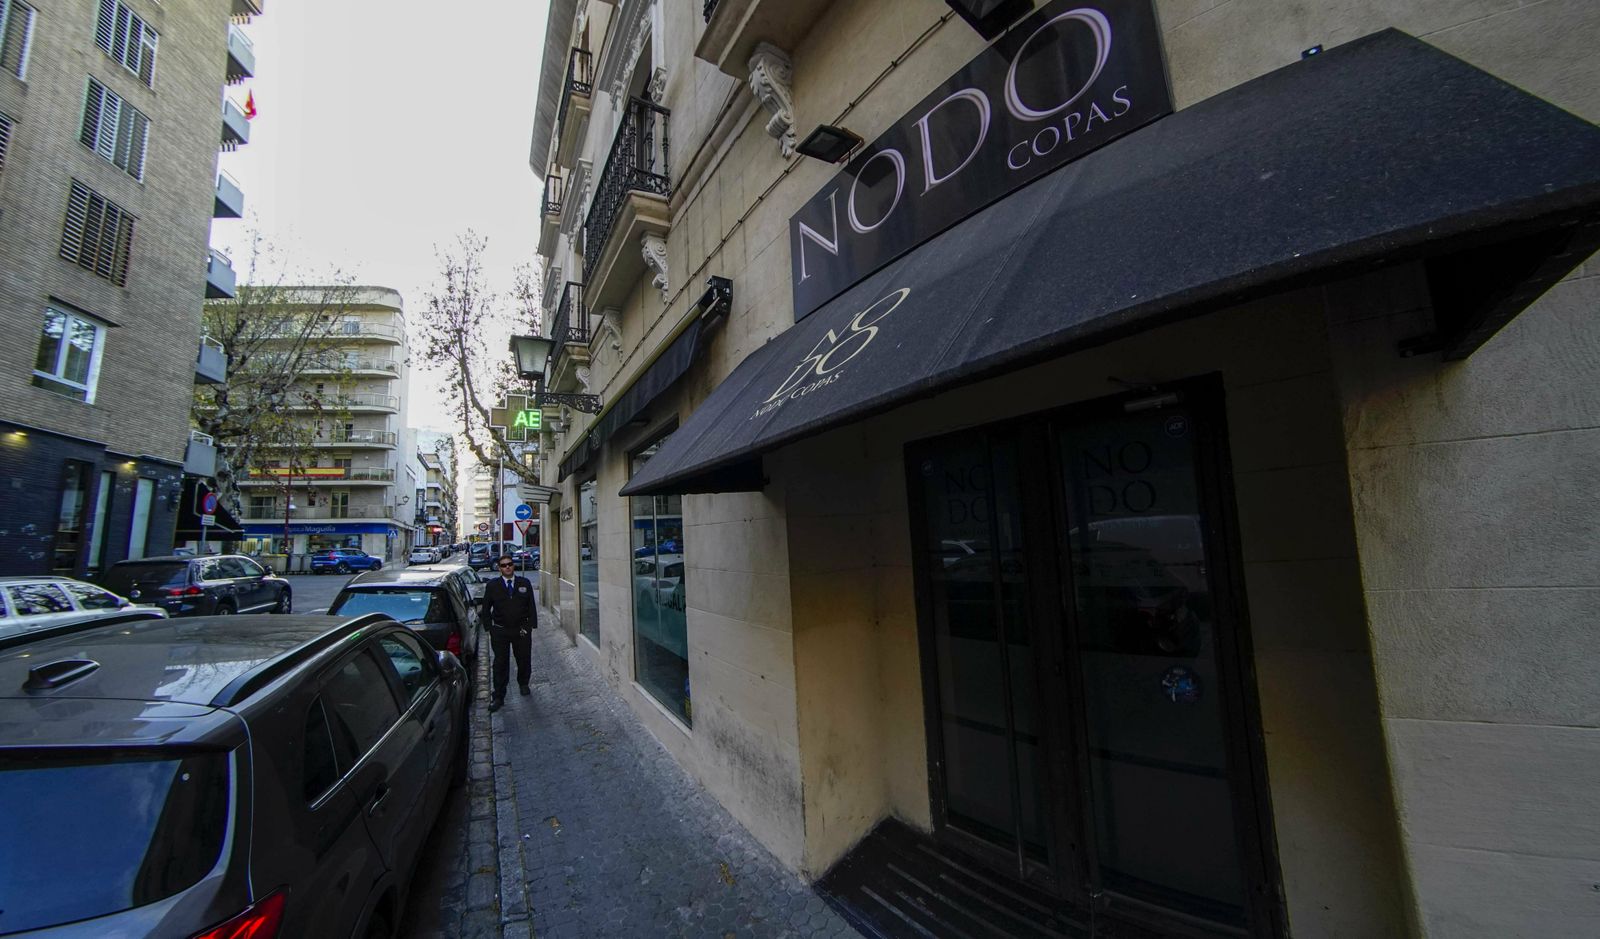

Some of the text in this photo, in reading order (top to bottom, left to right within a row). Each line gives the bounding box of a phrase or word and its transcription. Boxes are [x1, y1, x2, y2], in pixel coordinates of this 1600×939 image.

[798, 7, 1112, 285] NODO
[1007, 85, 1131, 171] COPAS
[790, 369, 844, 399] COPAS
[1082, 441, 1152, 480] NO
[1088, 480, 1156, 516] DO
